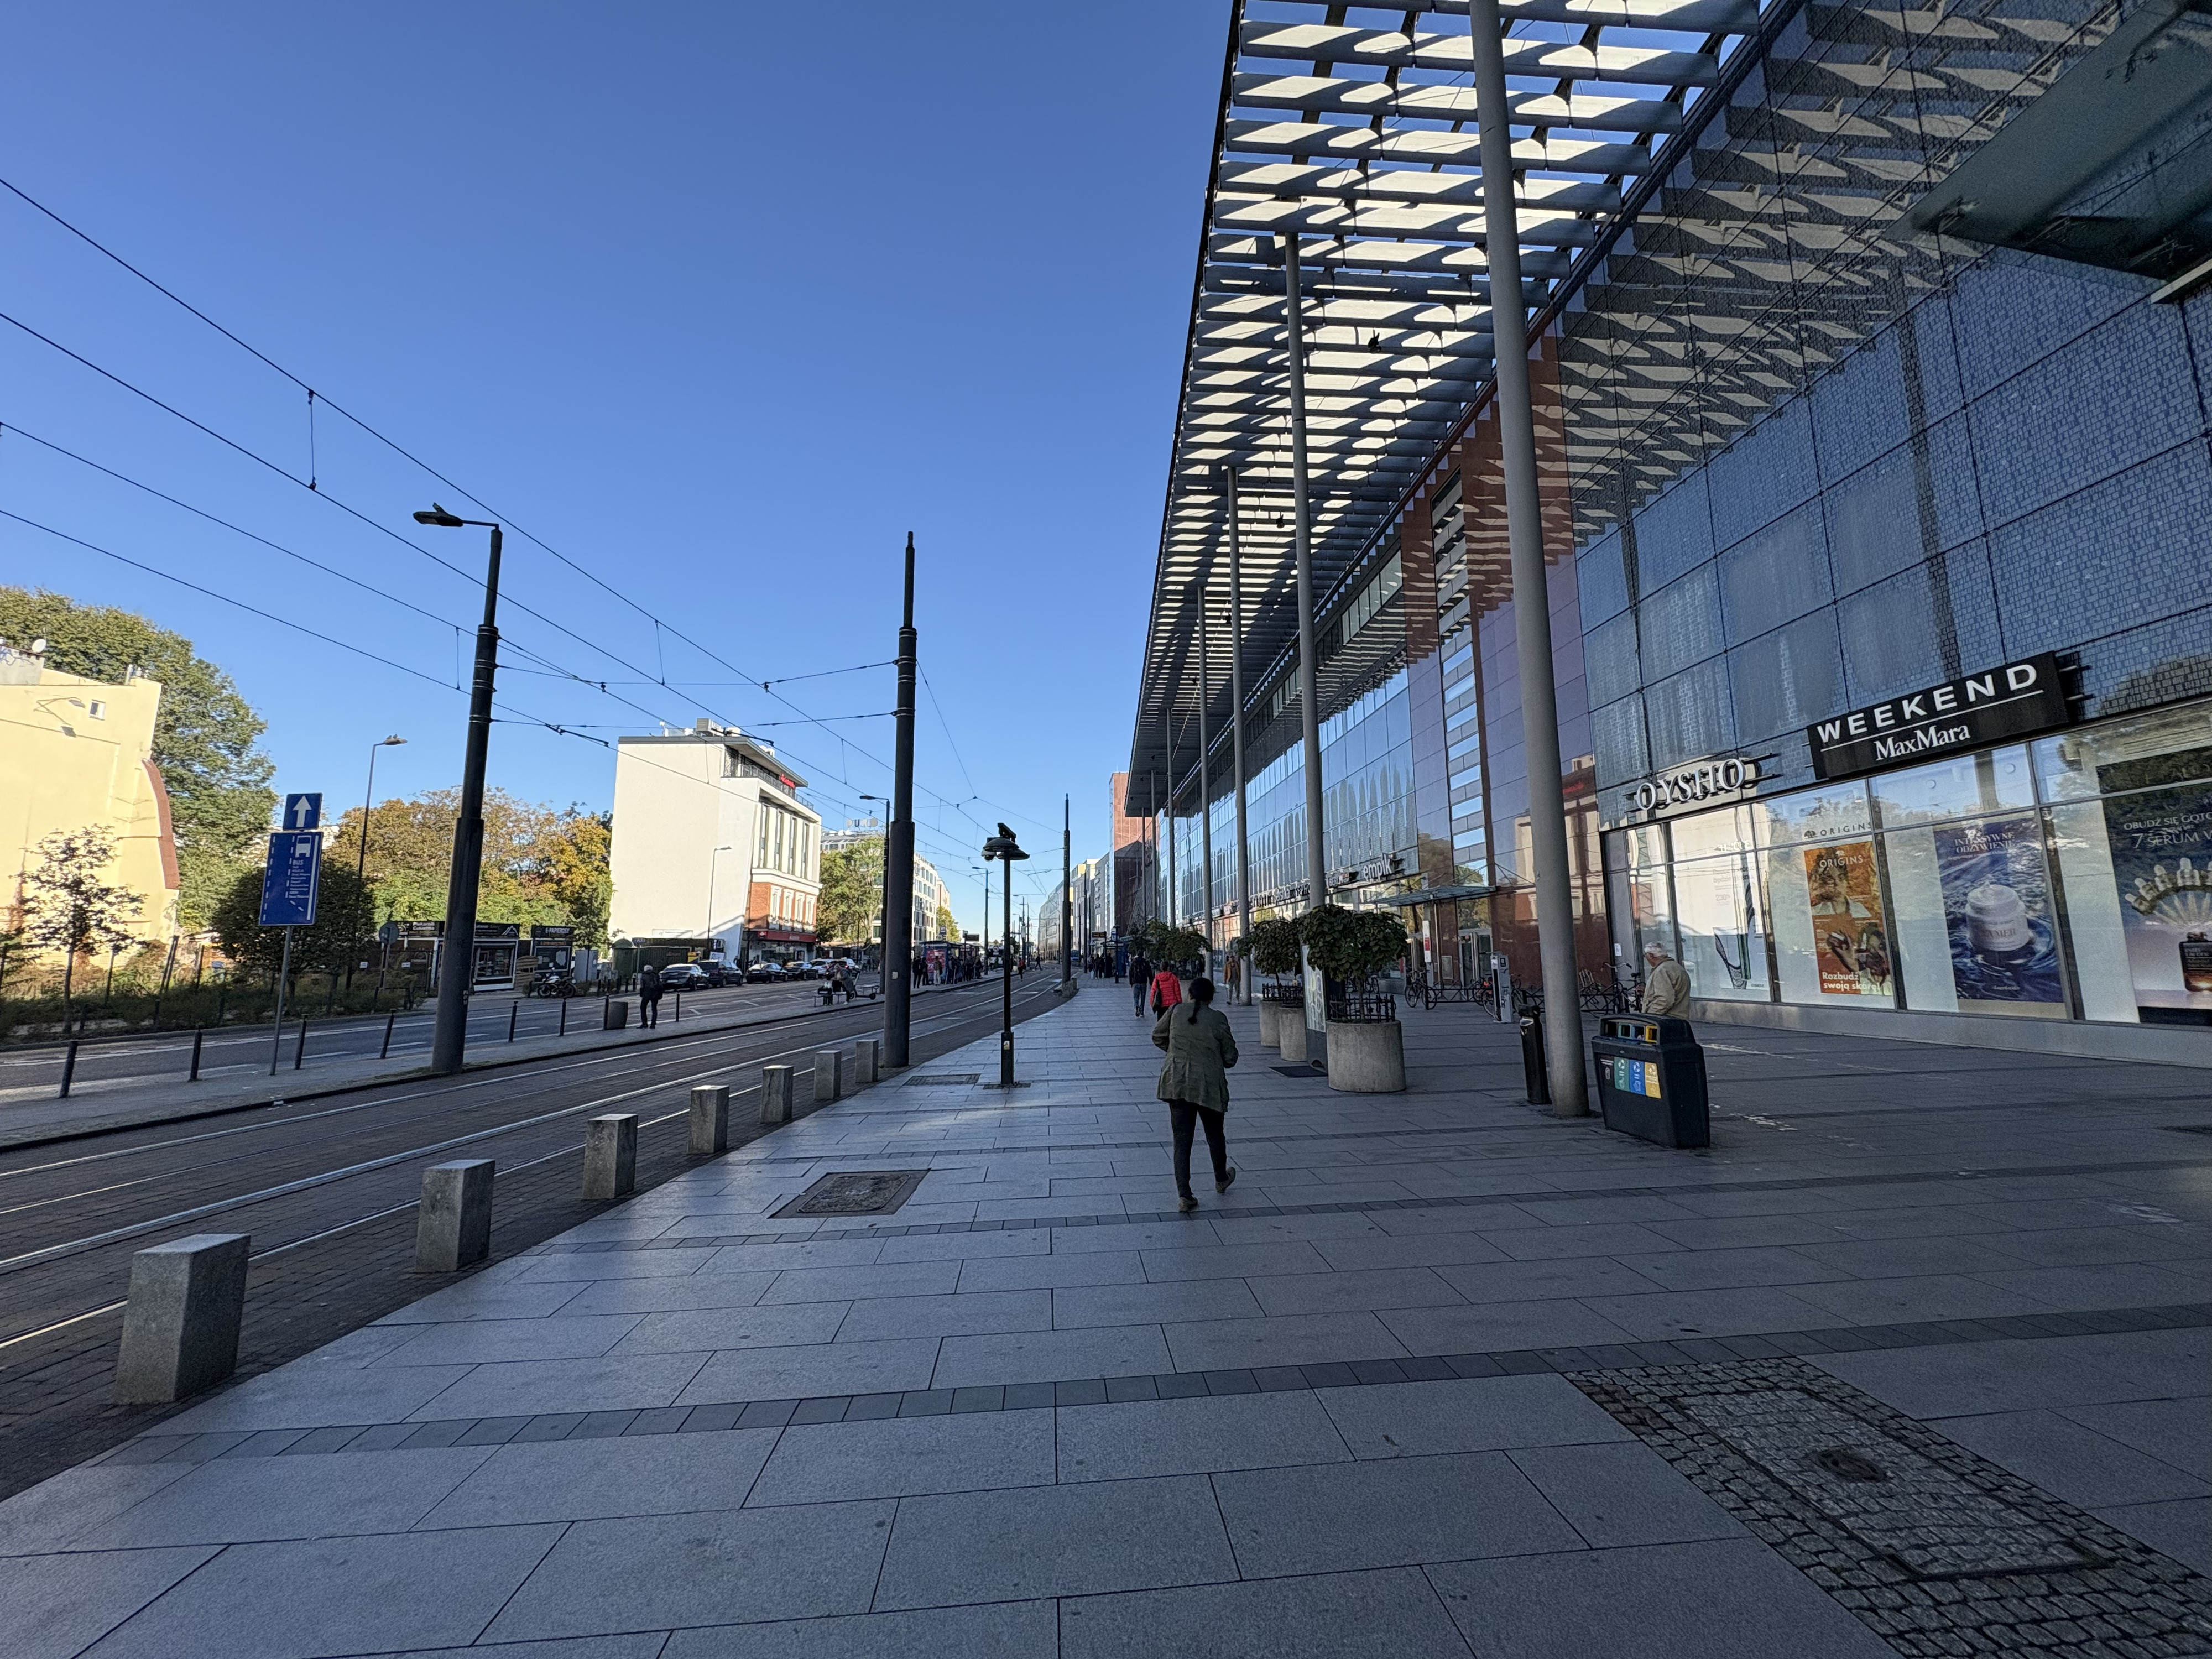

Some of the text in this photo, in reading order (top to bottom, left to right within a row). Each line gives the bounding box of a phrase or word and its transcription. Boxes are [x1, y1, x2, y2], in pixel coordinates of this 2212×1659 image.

[1817, 665, 2037, 743] WEEKEND
[1874, 725, 1971, 761] MaxMara
[1635, 758, 1744, 810] OYSHO
[2124, 817, 2162, 830] OBUDŹ
[2164, 816, 2179, 826] SIĘ
[2147, 832, 2199, 847] SERUM
[1363, 854, 1392, 880] empik
[1819, 855, 1863, 868] ORIGINS
[1822, 972, 1859, 980] Rozbudź
[1823, 980, 1850, 992] swoją
